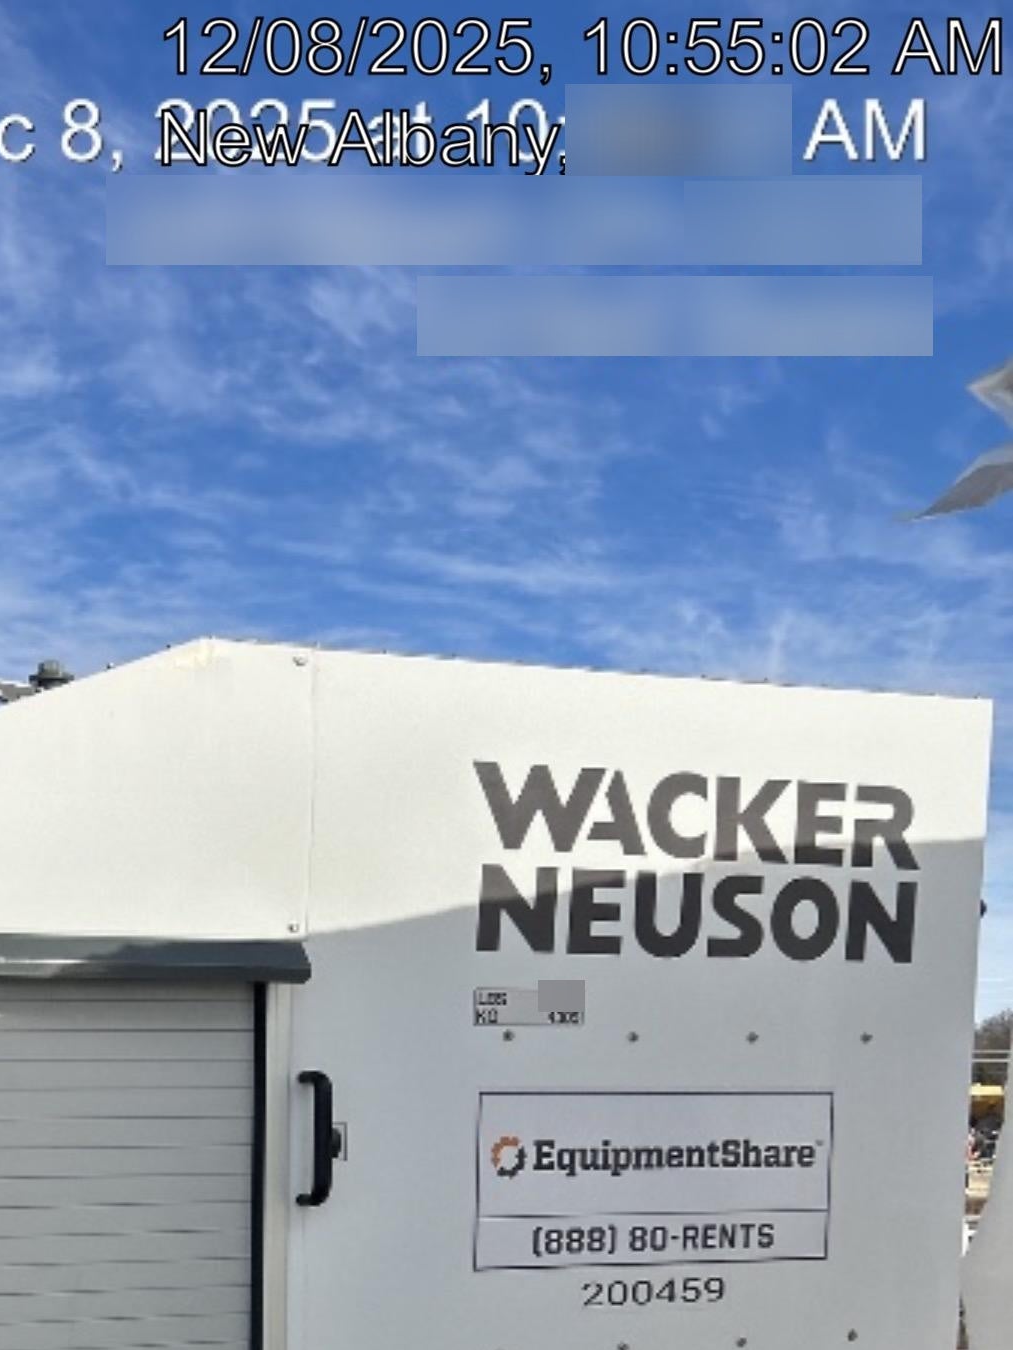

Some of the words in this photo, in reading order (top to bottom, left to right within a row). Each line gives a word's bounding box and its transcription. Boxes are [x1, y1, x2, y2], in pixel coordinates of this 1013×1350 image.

[473, 760, 920, 872] WACKER
[475, 863, 918, 964] NEUSON
[533, 1138, 816, 1177] EquipmentShare
[532, 1224, 617, 1257] (888)
[628, 1223, 776, 1252] 80-RENTS
[581, 1276, 726, 1307] 200459
